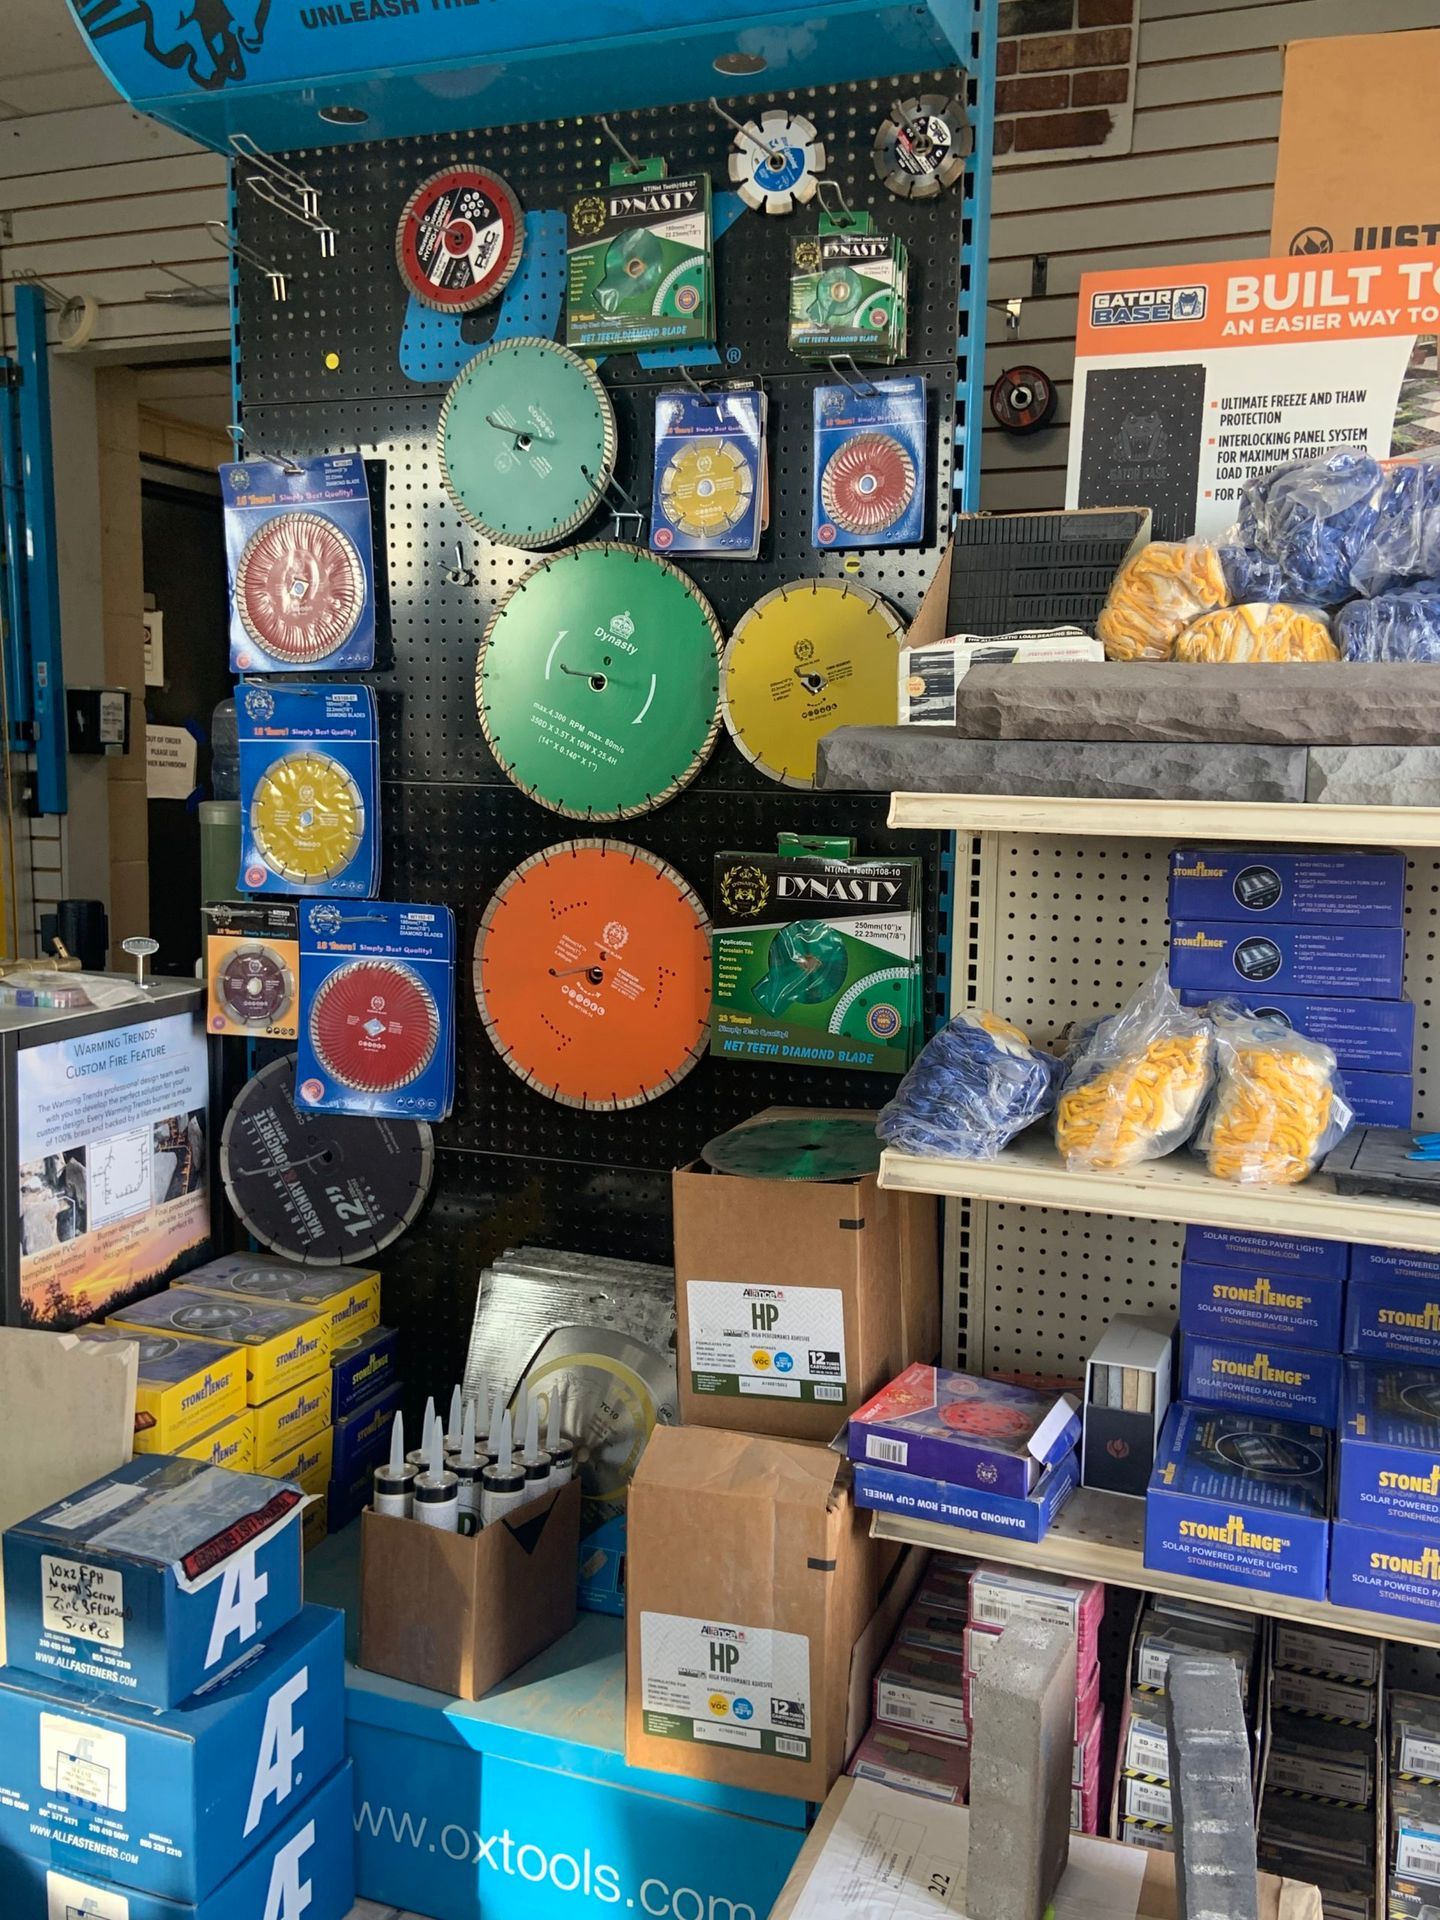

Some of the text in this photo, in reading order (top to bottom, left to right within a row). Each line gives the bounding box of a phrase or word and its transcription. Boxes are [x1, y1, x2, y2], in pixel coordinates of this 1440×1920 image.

[300, 0, 420, 29] UNLEASH
[610, 191, 698, 217] DYNASTY
[823, 243, 888, 258] DYNASTY
[1094, 290, 1172, 308] GATOR
[1226, 262, 1440, 314] BUILT T
[1093, 304, 1171, 325] BASE
[1221, 306, 1439, 336] AN EASIER WAY TO
[1221, 390, 1367, 410] ULTIMATE FREEZE AND THAW
[1220, 411, 1282, 426] PROTECTION
[1218, 428, 1368, 447] INTERLOCKING PANEL SYSTEM
[1217, 449, 1289, 464] FOR MAXIMUM
[1216, 467, 1242, 480] LOAD
[324, 489, 354, 499] Quality!
[1215, 488, 1234, 501] FOR
[594, 626, 639, 655] Dynasty
[530, 715, 618, 765] 350D X 3.5T X 10W X 25.4H
[553, 743, 559, 751] X
[569, 719, 586, 732] RPM
[604, 738, 625, 754] 80m/s
[776, 876, 902, 902] DYNASTY
[359, 944, 384, 953] Simply
[385, 945, 402, 953] Best
[403, 946, 433, 955] Quality!
[724, 1040, 875, 1064] NET TEETH DIAMOND BLADE
[104, 1079, 139, 1096] professional
[54, 1131, 72, 1146] 100%
[287, 1181, 326, 1239] MASONRY
[1203, 1231, 1324, 1255] SOLAR POWERED PAVER LIGHTS
[1370, 1255, 1439, 1271] SOLAR POWERED
[751, 1302, 779, 1331] HP
[1197, 1303, 1319, 1327] SOLAR POWERED PAVER LIGHTS
[1361, 1328, 1431, 1345] SOLAR POWERED
[276, 1336, 320, 1367] STONEHENGE
[809, 1351, 826, 1365] 12
[181, 1374, 231, 1411] STONEHENGE
[1196, 1377, 1317, 1404] SOLAR POWERED PAVER LIGHTS
[277, 1396, 320, 1429] STONEHENGE
[863, 1488, 1026, 1528] DIAMOND DOUBLE ROW CUP WHEEL
[1360, 1492, 1439, 1513] SOLAR POWERED
[1179, 1515, 1281, 1552] STONEHENGE
[1162, 1540, 1298, 1573] SOLAR POWERED PAVER LIGHTS
[1352, 1573, 1430, 1595] SOLAR POWERED
[35, 1651, 138, 1687] WWW.ALLFASTENERS.COM
[709, 1641, 740, 1674] HP
[710, 1702, 727, 1711] VOC
[772, 1699, 789, 1715] 12
[30, 1823, 139, 1865] WWW.ALLFASTENERS.COM
[353, 1799, 758, 1920] ww.oxtools.com
[927, 1872, 951, 1896] 2/2
